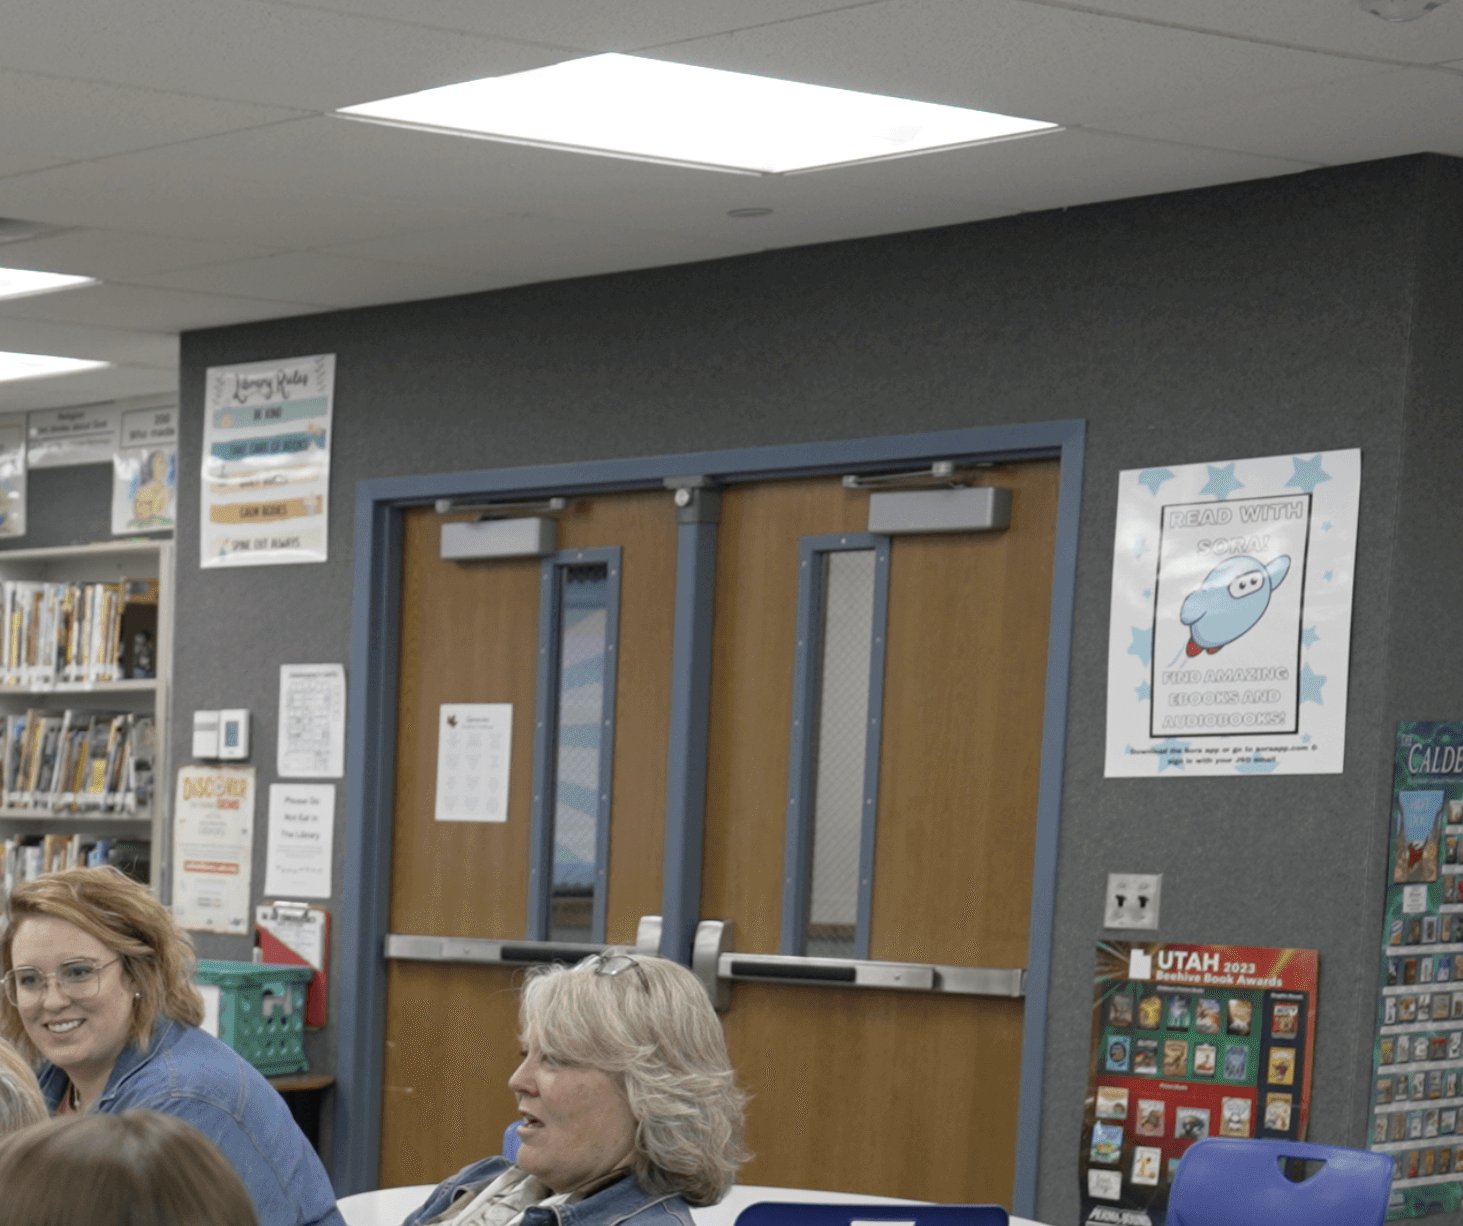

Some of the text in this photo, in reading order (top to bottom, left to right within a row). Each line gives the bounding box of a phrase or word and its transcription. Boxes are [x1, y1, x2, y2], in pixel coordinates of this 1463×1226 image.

[233, 369, 308, 404] Library Rules
[1169, 501, 1304, 529] READ WITH
[271, 536, 301, 549] ALWAYS
[1196, 534, 1271, 556] SORA!
[1161, 665, 1289, 685] FIND AMAZING
[1168, 688, 1282, 707] EBOOKS AND
[1161, 711, 1286, 729] AUDIOBOOKS!
[1157, 950, 1257, 974] UTAH 2023
[1156, 970, 1283, 988] Beehive Book Awards
